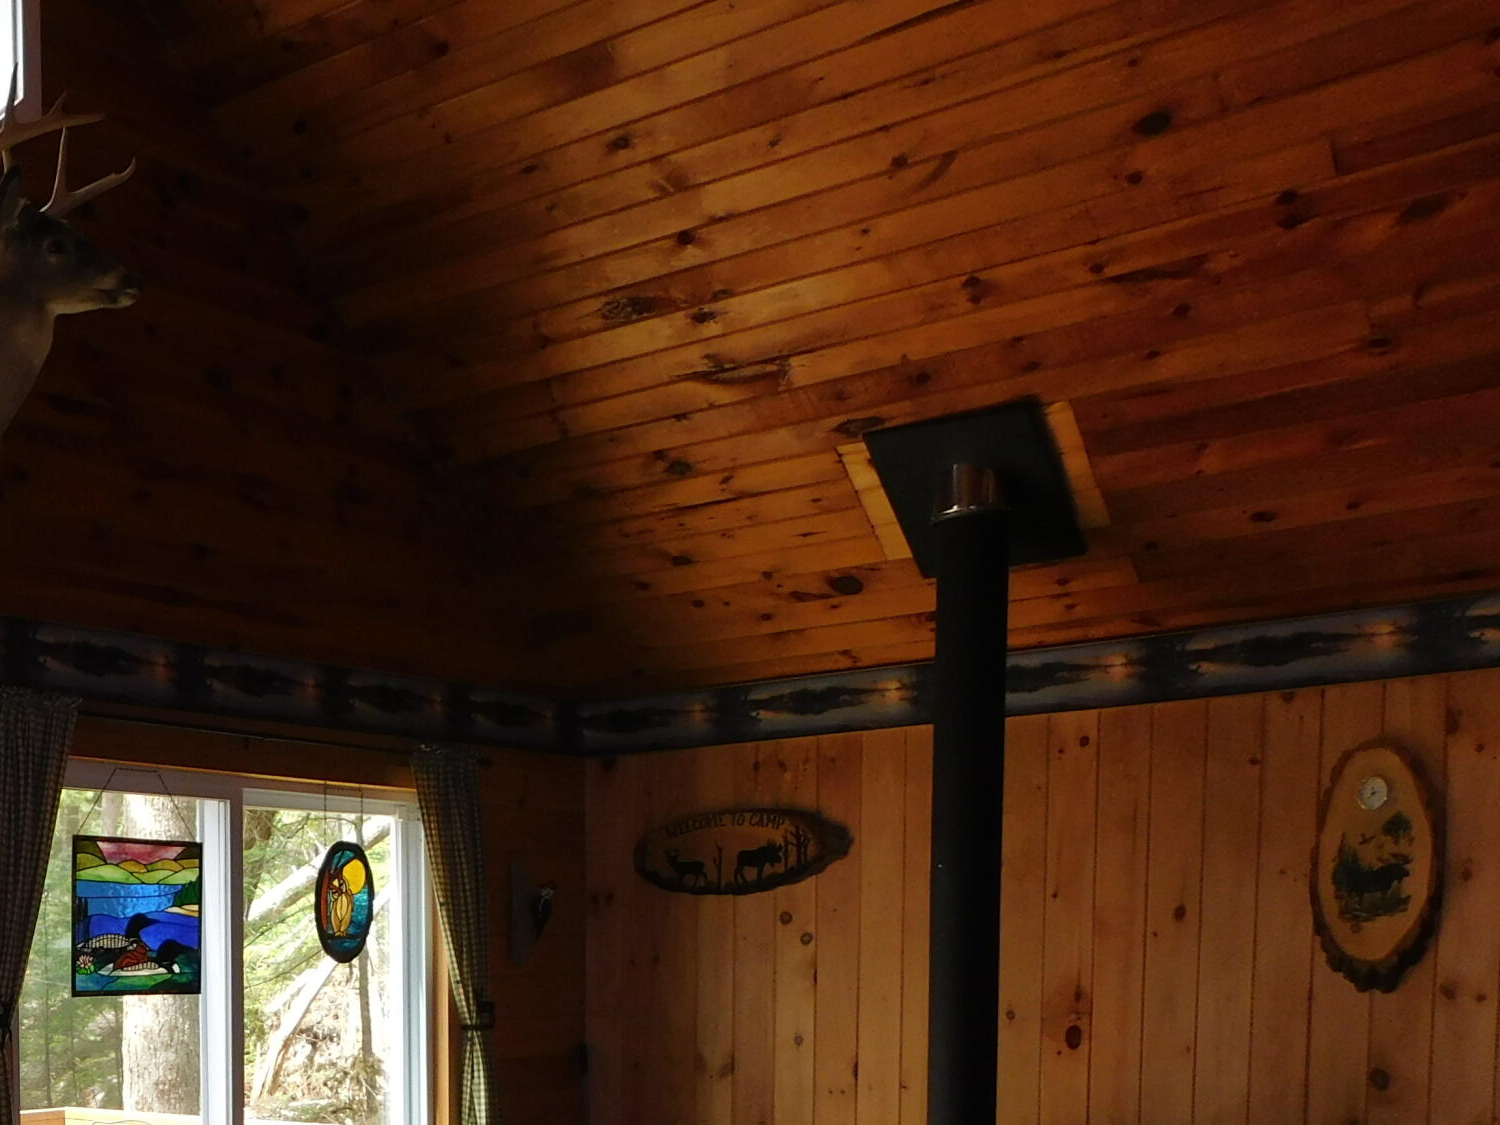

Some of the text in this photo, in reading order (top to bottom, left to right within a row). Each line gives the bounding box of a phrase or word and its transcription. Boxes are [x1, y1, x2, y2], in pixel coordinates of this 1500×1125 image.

[664, 812, 786, 839] WELCOME TO CAMP
